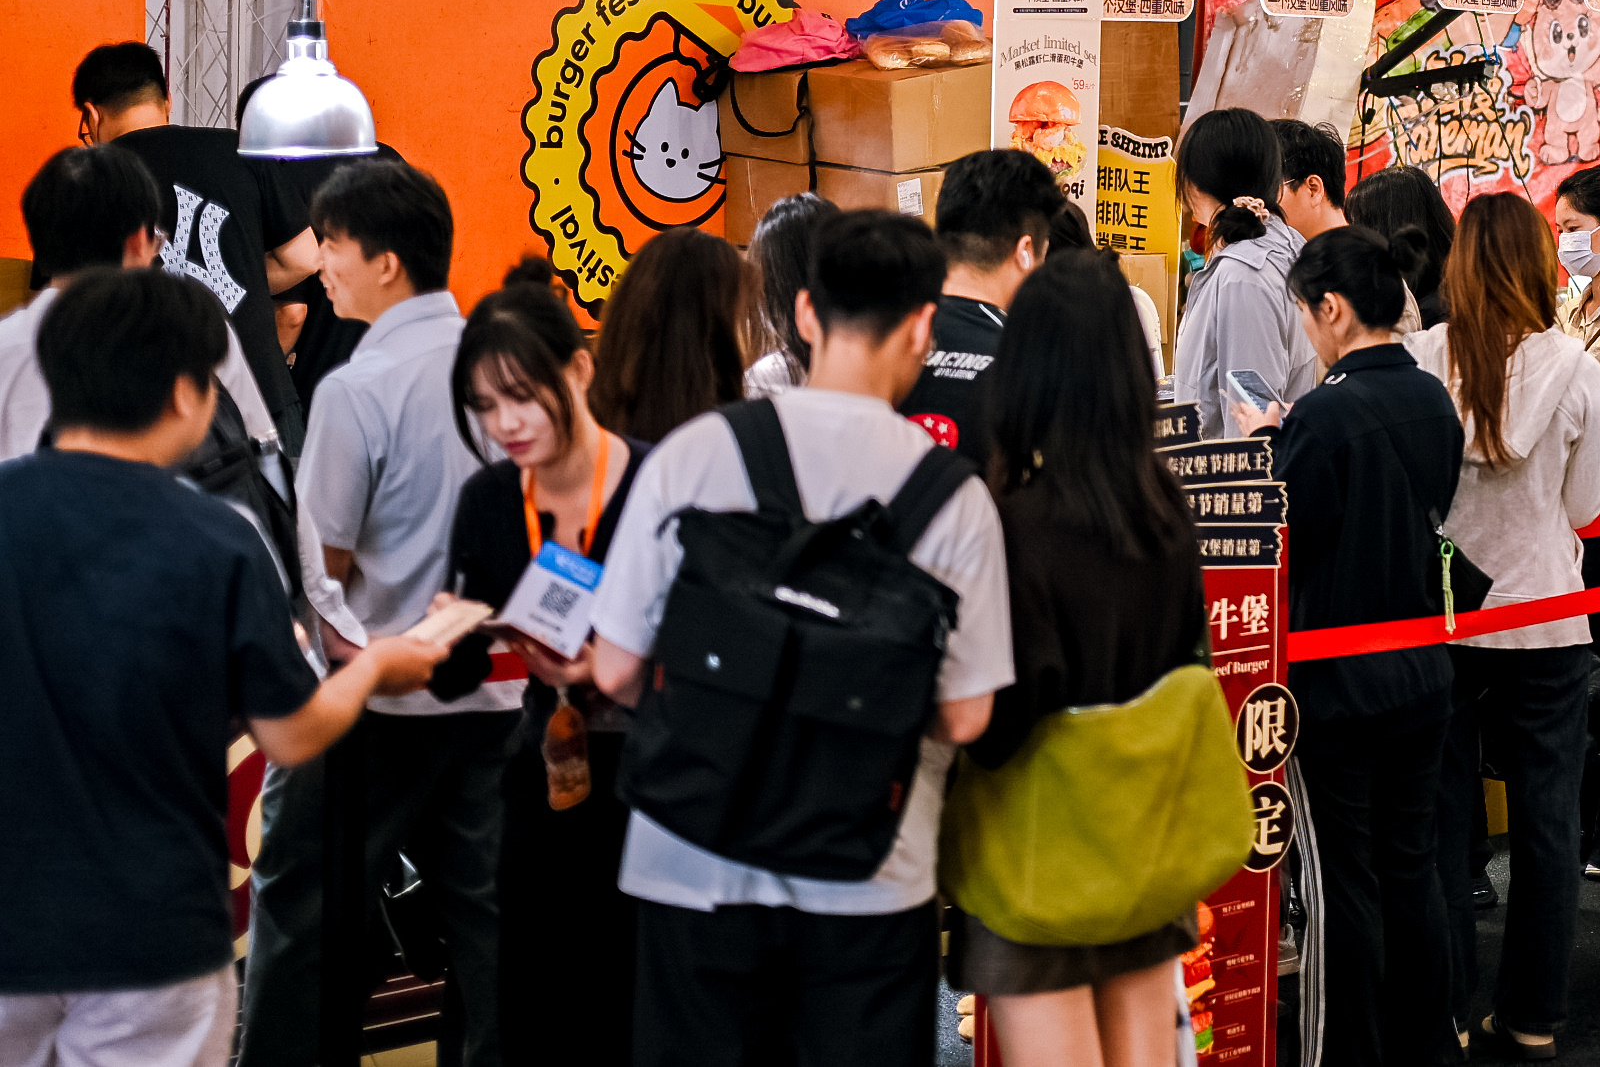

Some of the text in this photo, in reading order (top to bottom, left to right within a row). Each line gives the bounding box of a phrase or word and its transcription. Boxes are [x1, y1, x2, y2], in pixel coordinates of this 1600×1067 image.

[1000, 39, 1042, 70] Market
[1044, 34, 1081, 56] limited
[539, 21, 597, 150] burger
[1110, 129, 1169, 159] SHRIMP
[549, 203, 622, 291] stival
[926, 350, 995, 371] ACING
[1209, 592, 1270, 641] 牛堡
[1232, 657, 1271, 675] Burger
